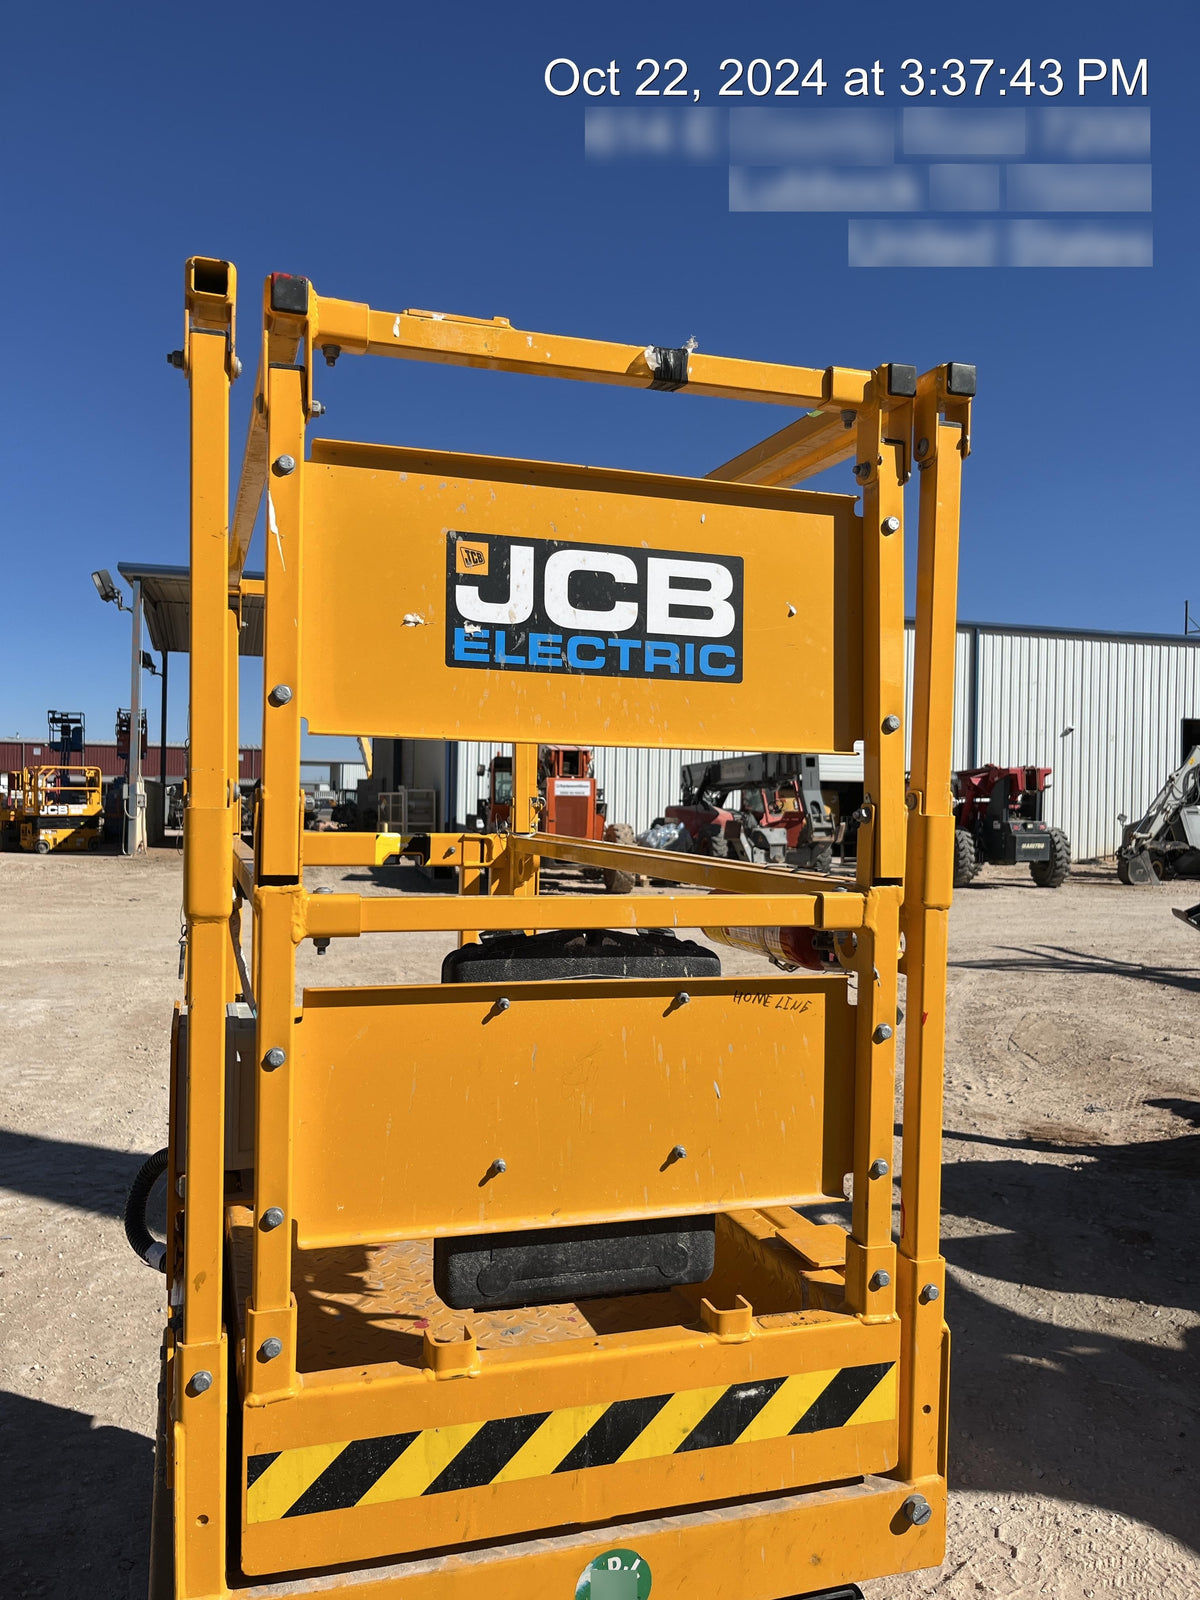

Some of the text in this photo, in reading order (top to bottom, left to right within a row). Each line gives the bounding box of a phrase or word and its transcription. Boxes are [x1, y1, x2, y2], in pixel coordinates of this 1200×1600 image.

[464, 549, 484, 566] JCB
[455, 544, 736, 638] JCB
[454, 628, 736, 677] ELECTRIC
[39, 805, 68, 815] JCB
[733, 990, 773, 1007] HOME
